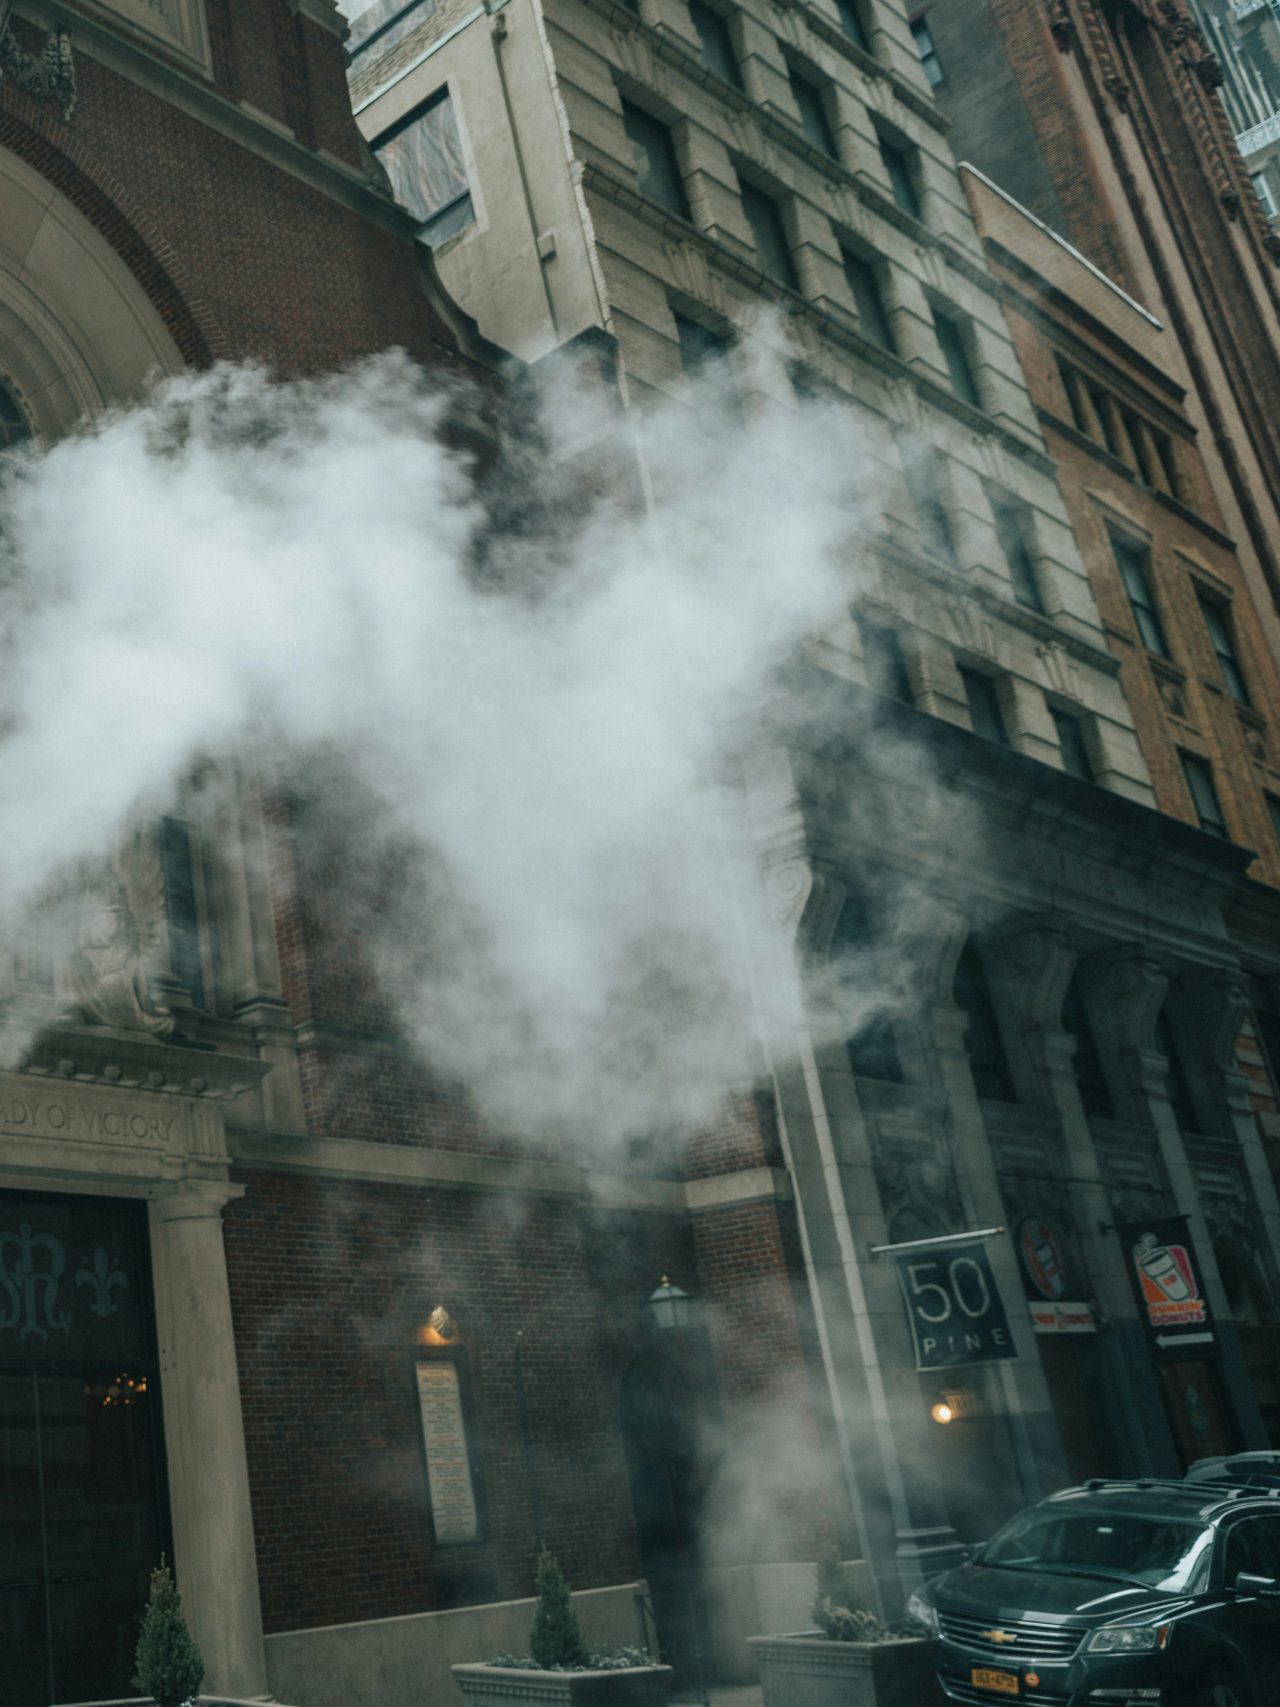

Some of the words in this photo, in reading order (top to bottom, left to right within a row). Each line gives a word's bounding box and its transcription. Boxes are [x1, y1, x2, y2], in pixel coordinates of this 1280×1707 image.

[46, 1104, 78, 1130] OF
[79, 1108, 176, 1141] VICTORY
[907, 1257, 990, 1323] 50
[1151, 1310, 1204, 1323] DONUTS
[923, 1328, 1007, 1354] PINE
